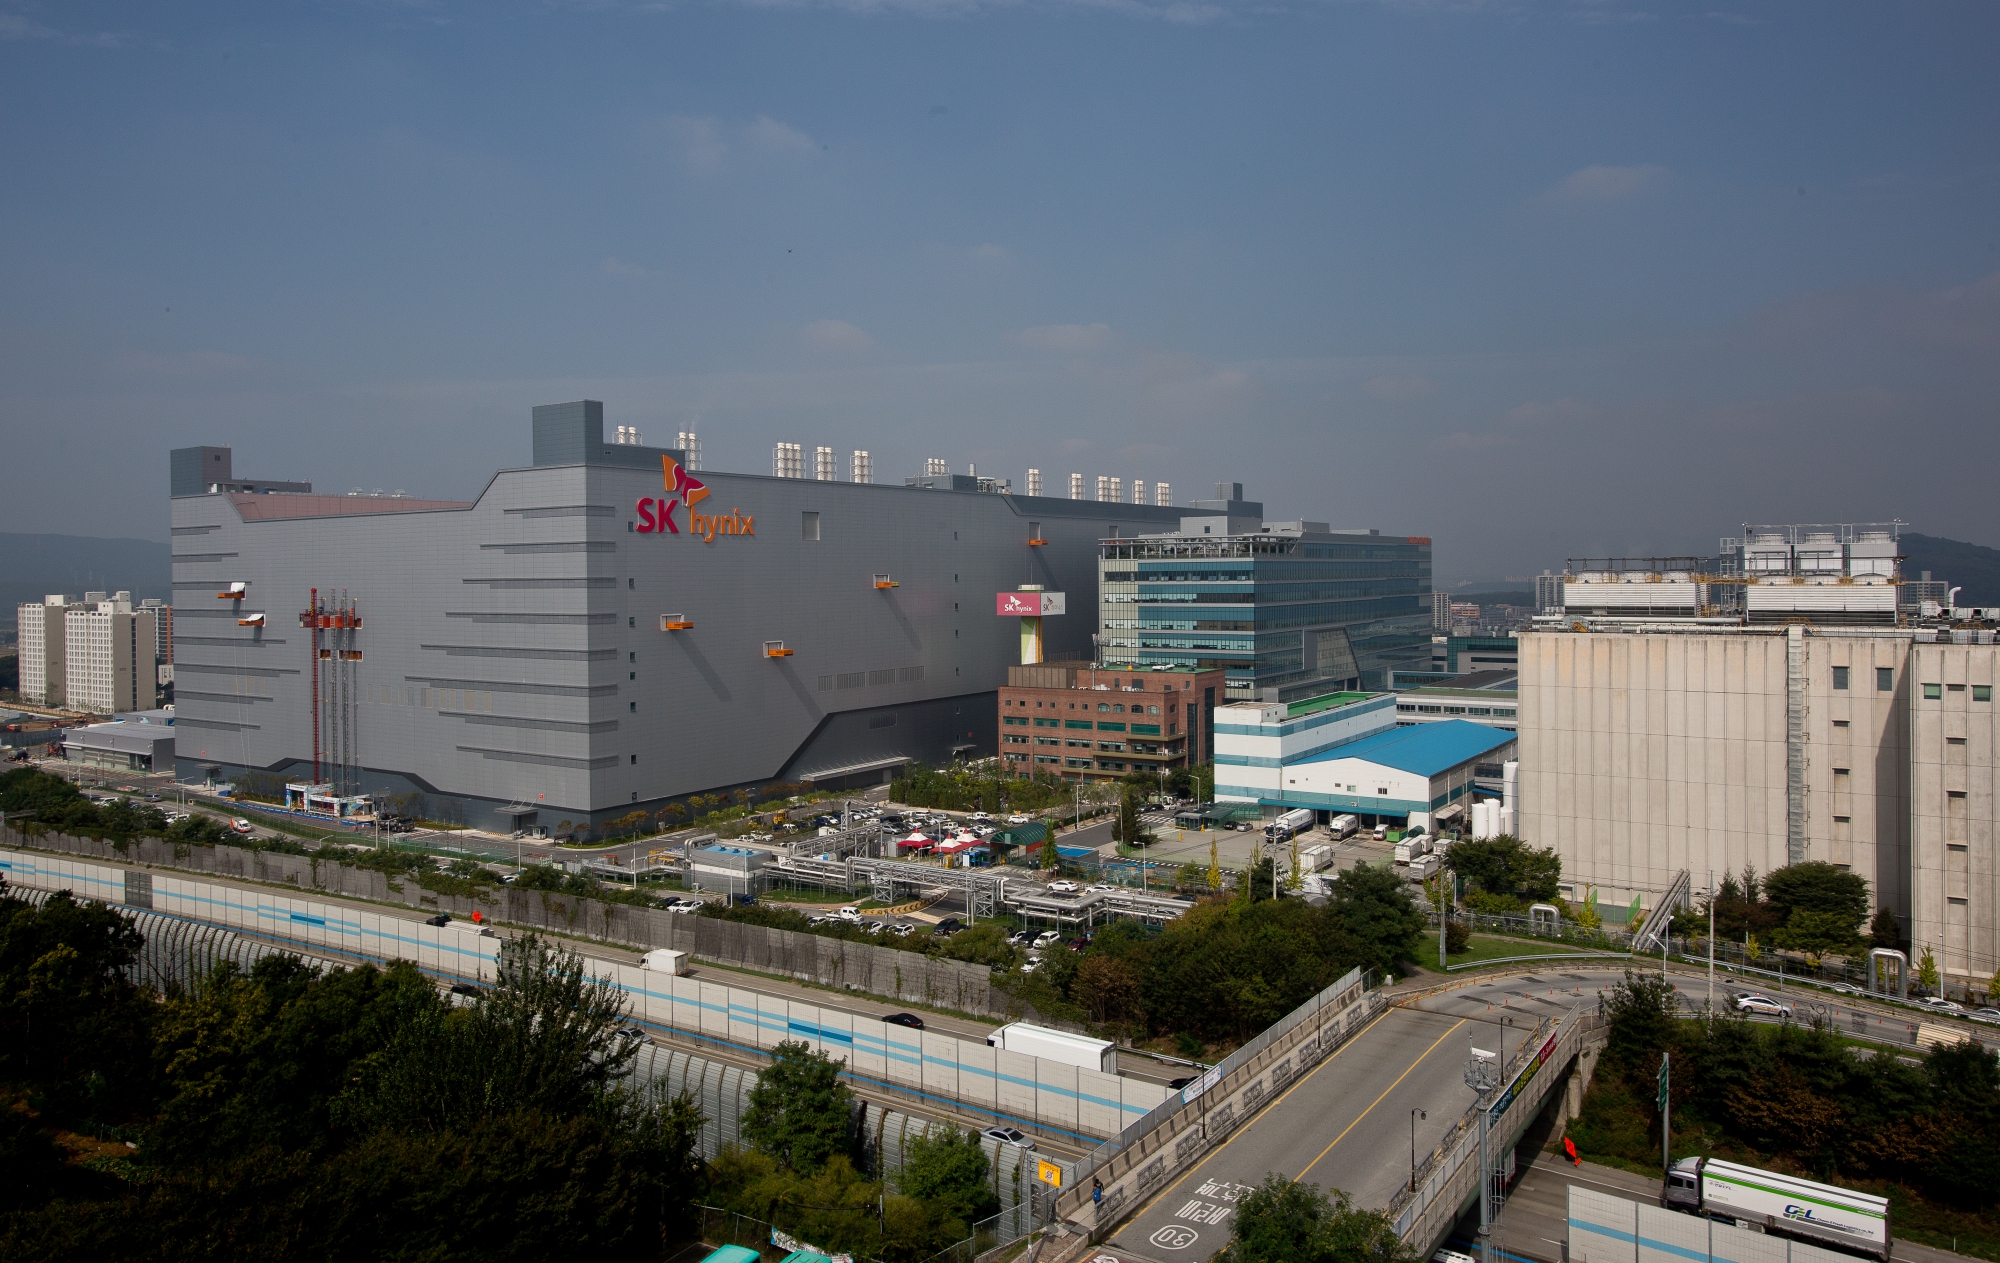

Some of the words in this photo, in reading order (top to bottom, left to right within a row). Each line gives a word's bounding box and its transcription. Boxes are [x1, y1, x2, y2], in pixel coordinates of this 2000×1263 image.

[636, 497, 679, 534] SK
[690, 505, 755, 543] hynix
[1016, 605, 1032, 614] hynix
[1174, 1199, 1232, 1225] 어린이
[1157, 1229, 1192, 1246] 30
